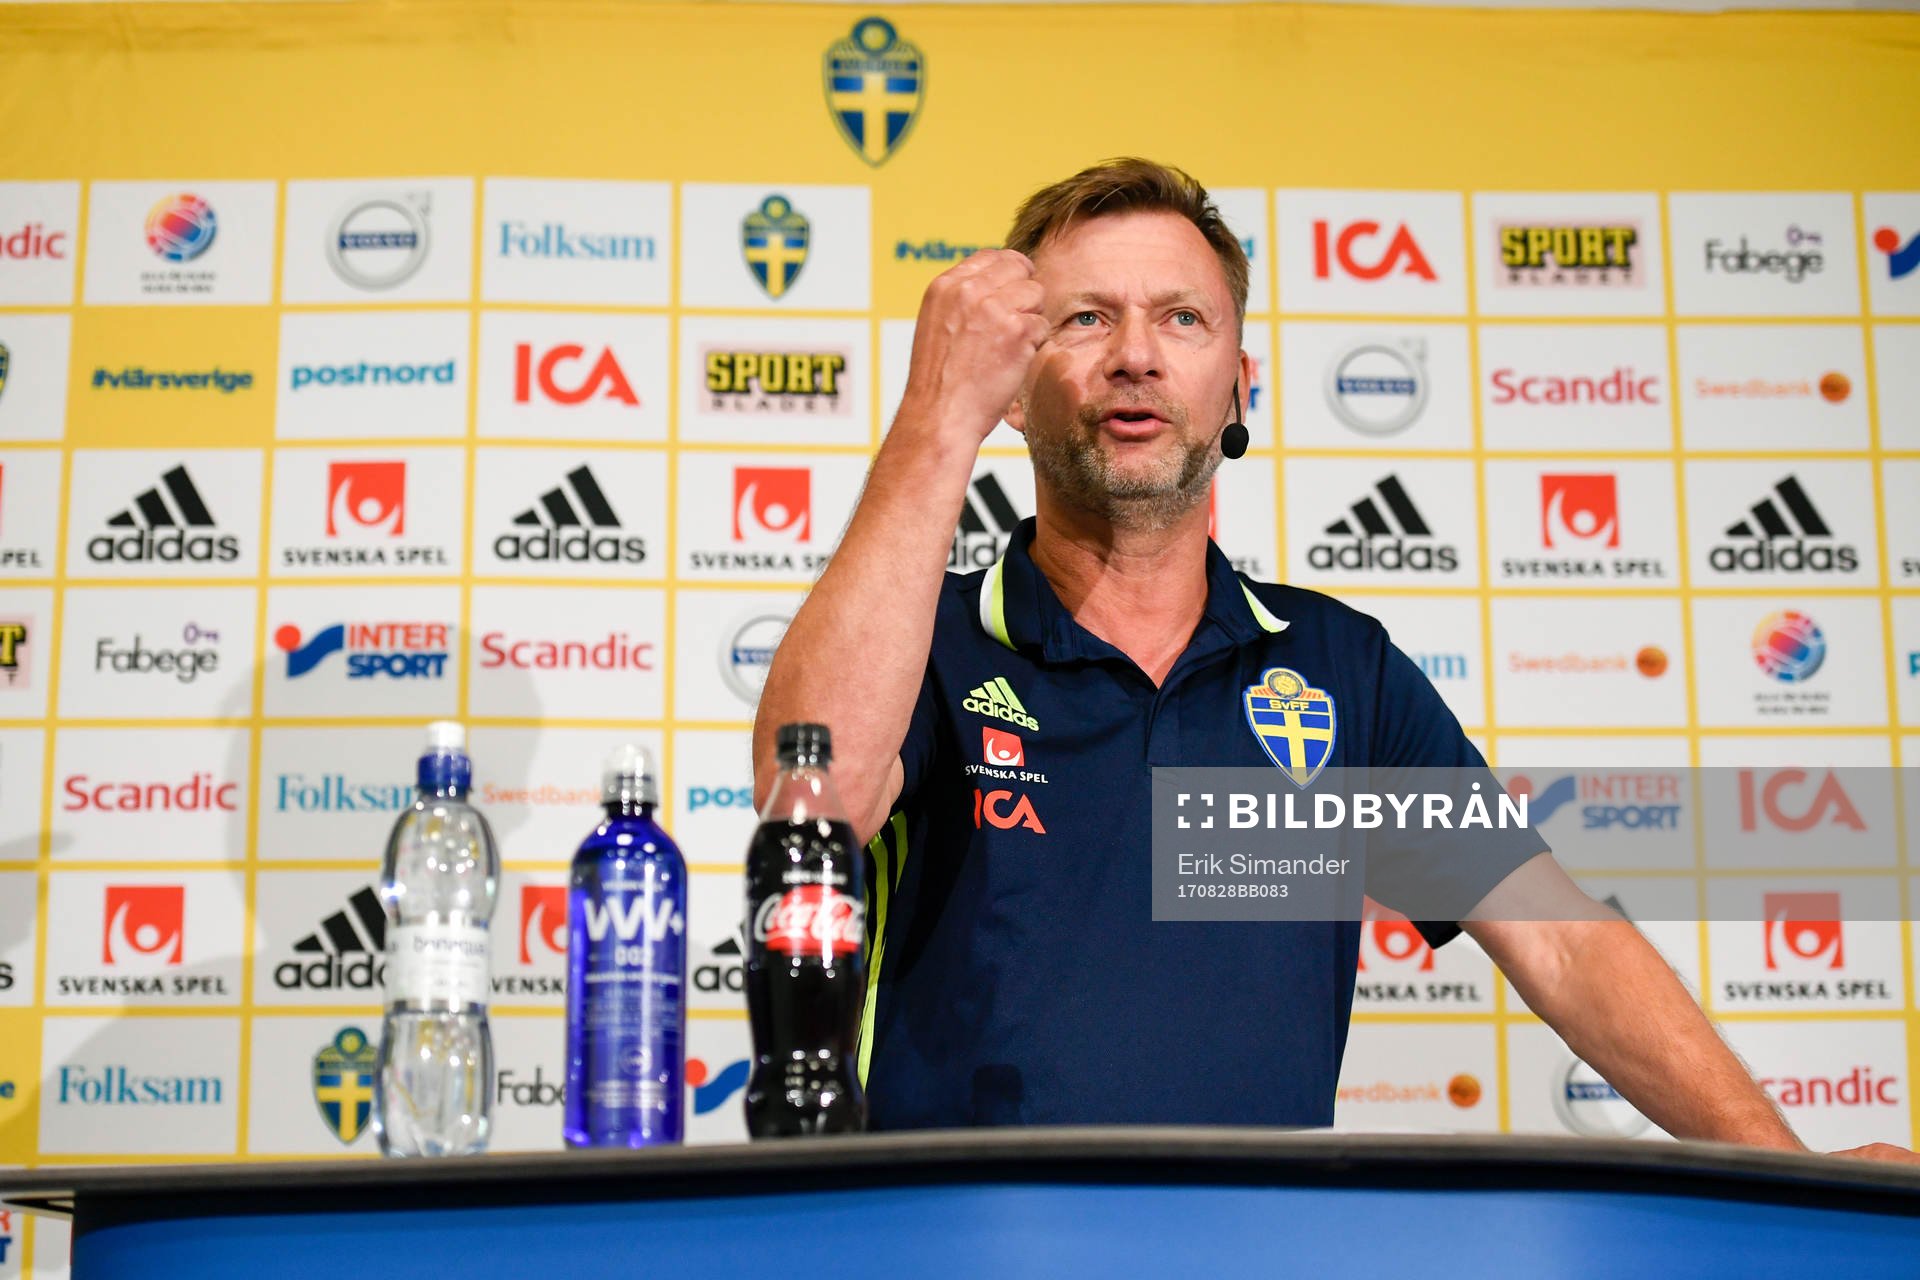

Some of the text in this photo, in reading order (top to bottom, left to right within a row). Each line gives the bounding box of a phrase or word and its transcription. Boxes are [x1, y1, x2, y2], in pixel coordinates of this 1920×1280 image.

[499, 221, 656, 261] Folksam
[1312, 219, 1438, 282] ICA
[1501, 226, 1637, 270] SPORT
[1705, 238, 1823, 283] Fabege
[290, 360, 456, 391] postnord
[514, 343, 640, 407] ICA
[705, 350, 845, 394] SPORT
[1491, 368, 1659, 405] Scandic
[710, 397, 842, 413] BLADET
[0, 551, 39, 568] PEL
[87, 530, 239, 563] adidas
[284, 548, 447, 566] SVENSKA SPEL
[494, 530, 646, 564] adidas
[690, 553, 793, 570] SVENSKA
[1307, 542, 1458, 573] adidas
[1709, 542, 1859, 573] adidas
[1503, 559, 1664, 577] SVENSKA SPEL
[348, 622, 448, 649] INTER
[480, 632, 652, 670] Scandic
[96, 633, 219, 683] Fabege
[347, 652, 448, 680] SPORT
[1508, 652, 1629, 674] Swedbank
[963, 697, 1039, 732] adidas
[965, 764, 1048, 784] SVENSKA SPEL
[1581, 775, 1678, 799] INTER
[64, 773, 238, 812] Scandic
[1739, 769, 1866, 833] ICA
[973, 788, 1047, 834] ICA
[1582, 805, 1681, 830] SPORT
[59, 976, 227, 996] SVENSKA SPEL
[272, 953, 384, 991] adid
[1357, 981, 1480, 1002] NSKA SPEL
[1724, 980, 1890, 1000] SVENSKA SPEL
[58, 1065, 222, 1105] Folksam
[1339, 1080, 1441, 1103] wedbank
[1762, 1066, 1900, 1106] candic
